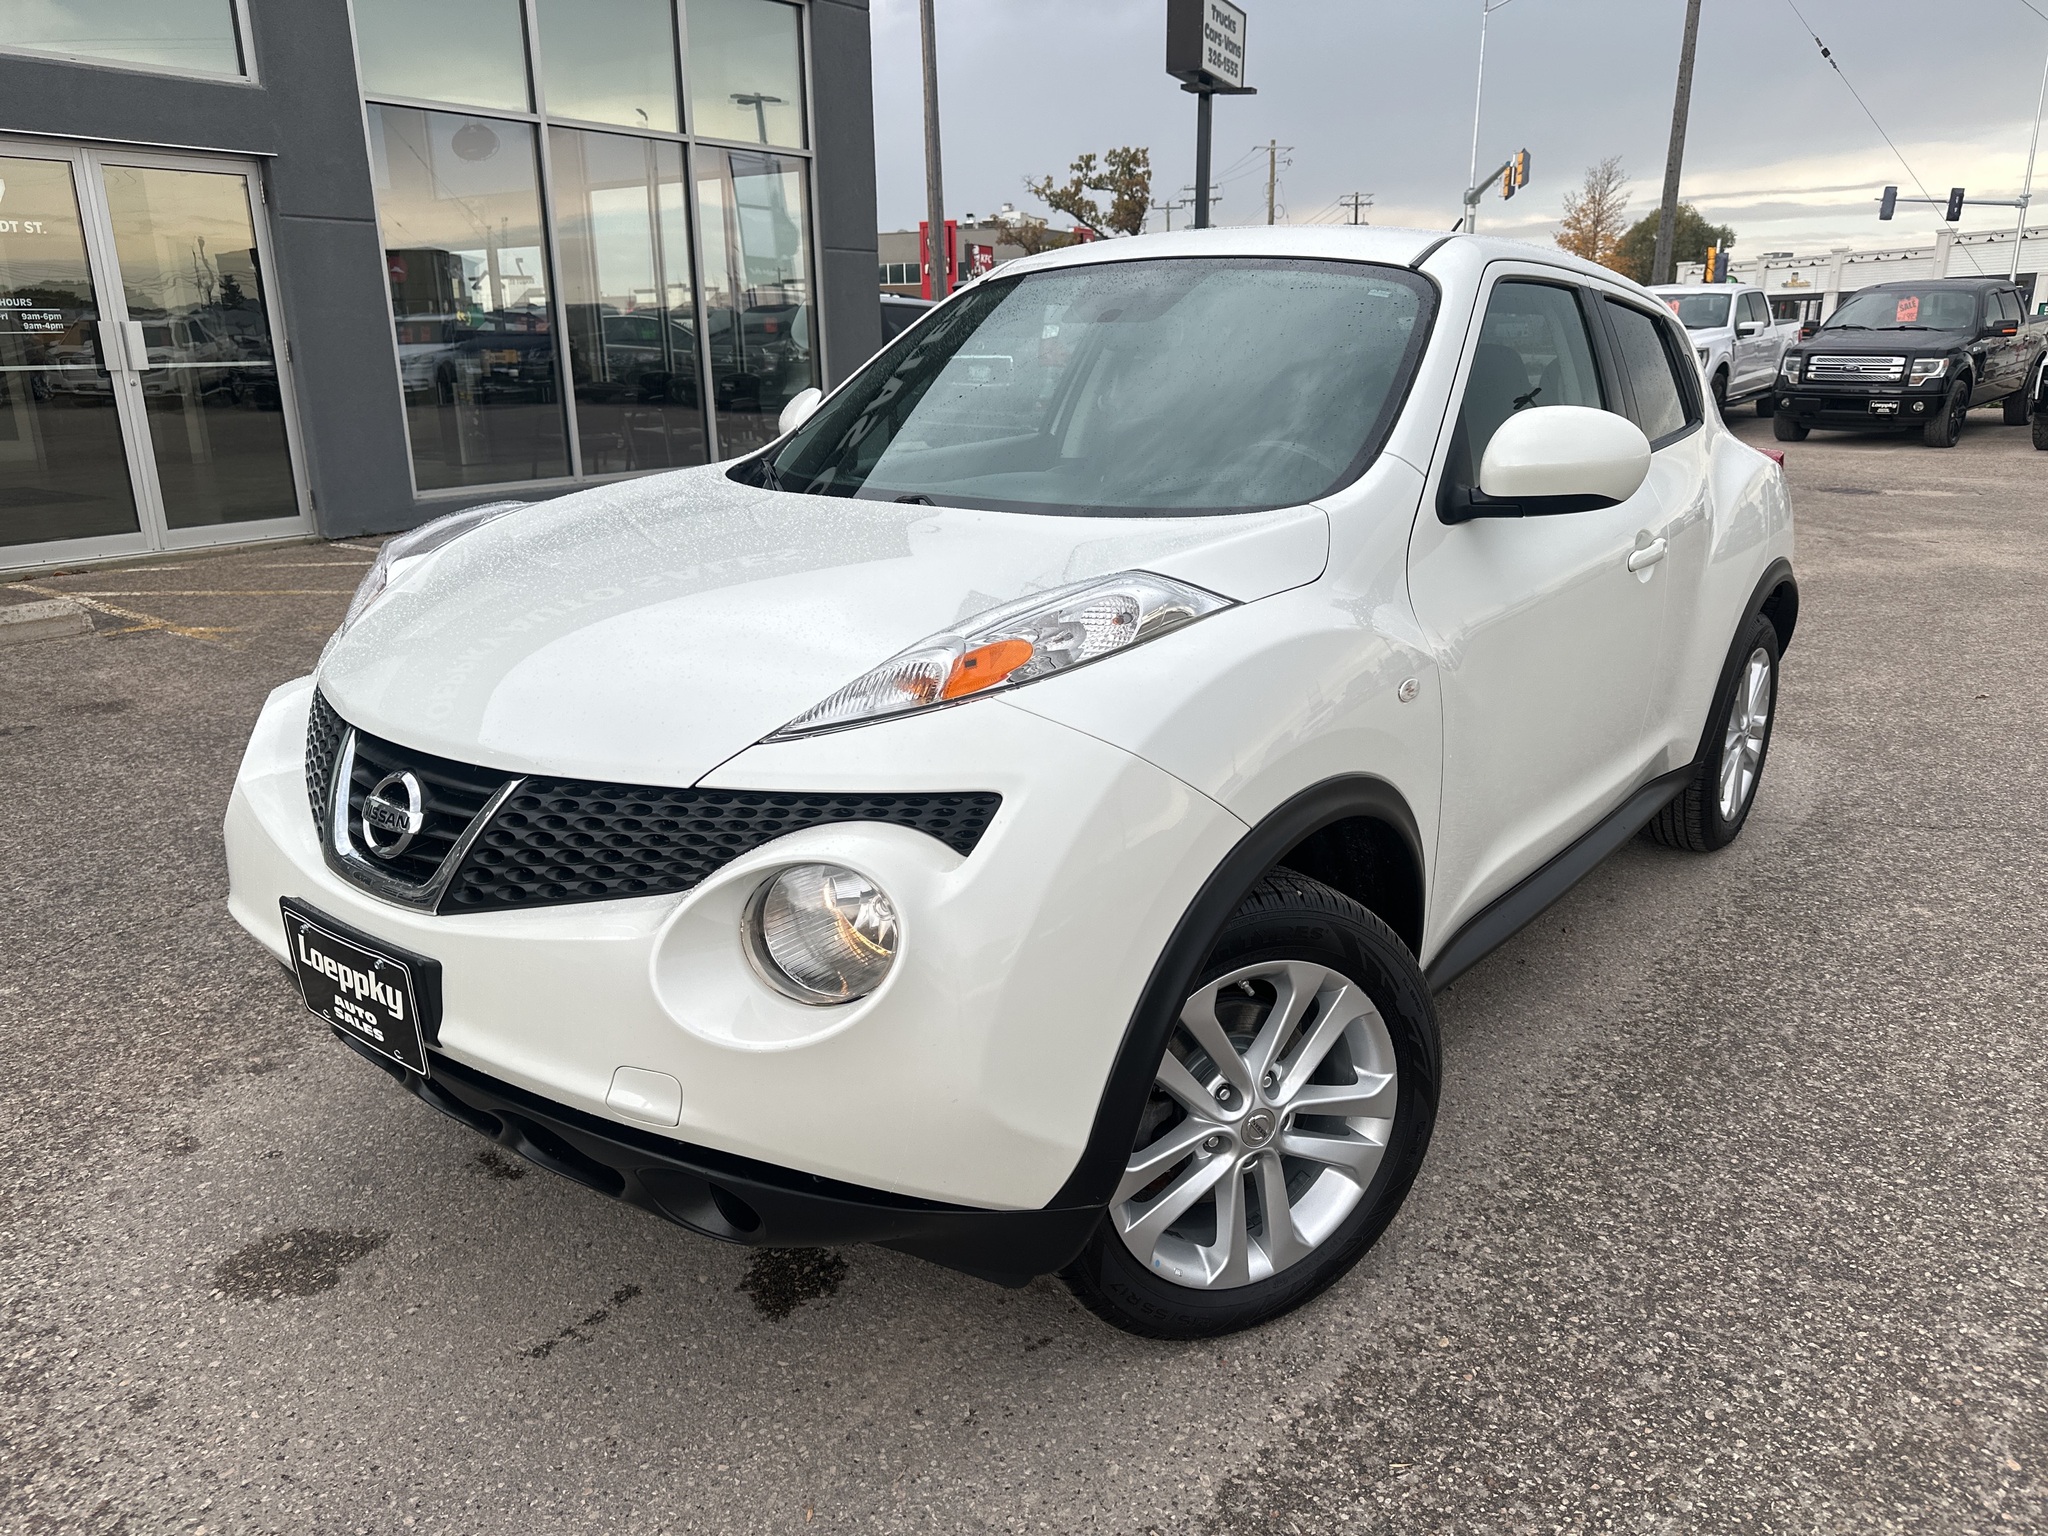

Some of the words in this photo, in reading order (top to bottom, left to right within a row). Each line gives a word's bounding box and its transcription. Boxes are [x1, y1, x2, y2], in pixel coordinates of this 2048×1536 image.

[1211, 4, 1236, 34] Trucks
[24, 221, 47, 234] ST.
[980, 254, 992, 264] KFC
[0, 298, 33, 306] HOURS
[1899, 300, 1917, 312] SALE
[21, 313, 62, 321] 9am-6pm
[23, 322, 64, 331] 9am-4pm
[363, 800, 410, 830] NISSAN
[297, 933, 404, 1021] Loeppky
[334, 994, 378, 1025] AUTO
[333, 1006, 385, 1042] SALES
